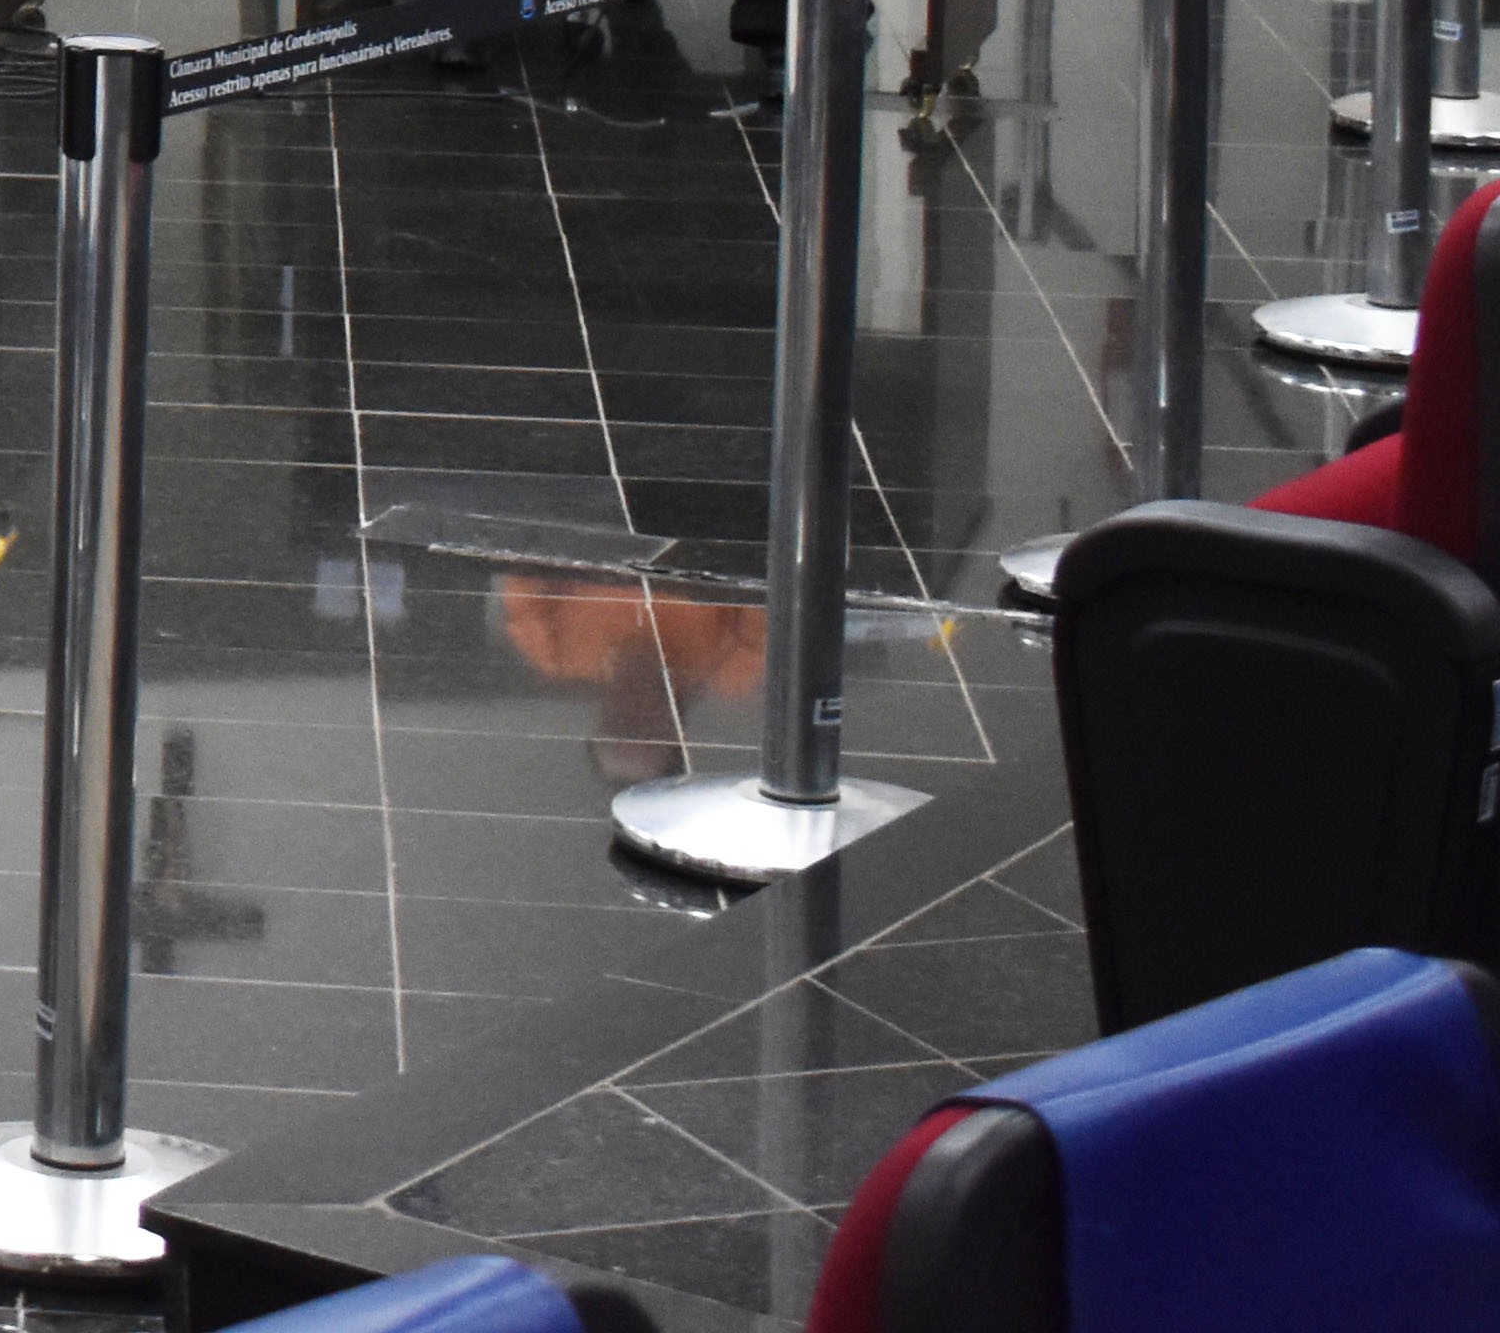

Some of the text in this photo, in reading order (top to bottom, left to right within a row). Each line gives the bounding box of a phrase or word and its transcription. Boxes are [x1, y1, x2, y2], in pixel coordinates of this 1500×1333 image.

[168, 27, 453, 108] Acesso restrito apenas para funcionários e Vereadores.
[169, 20, 358, 79] Câmara Municipal de Cordeirópolis
